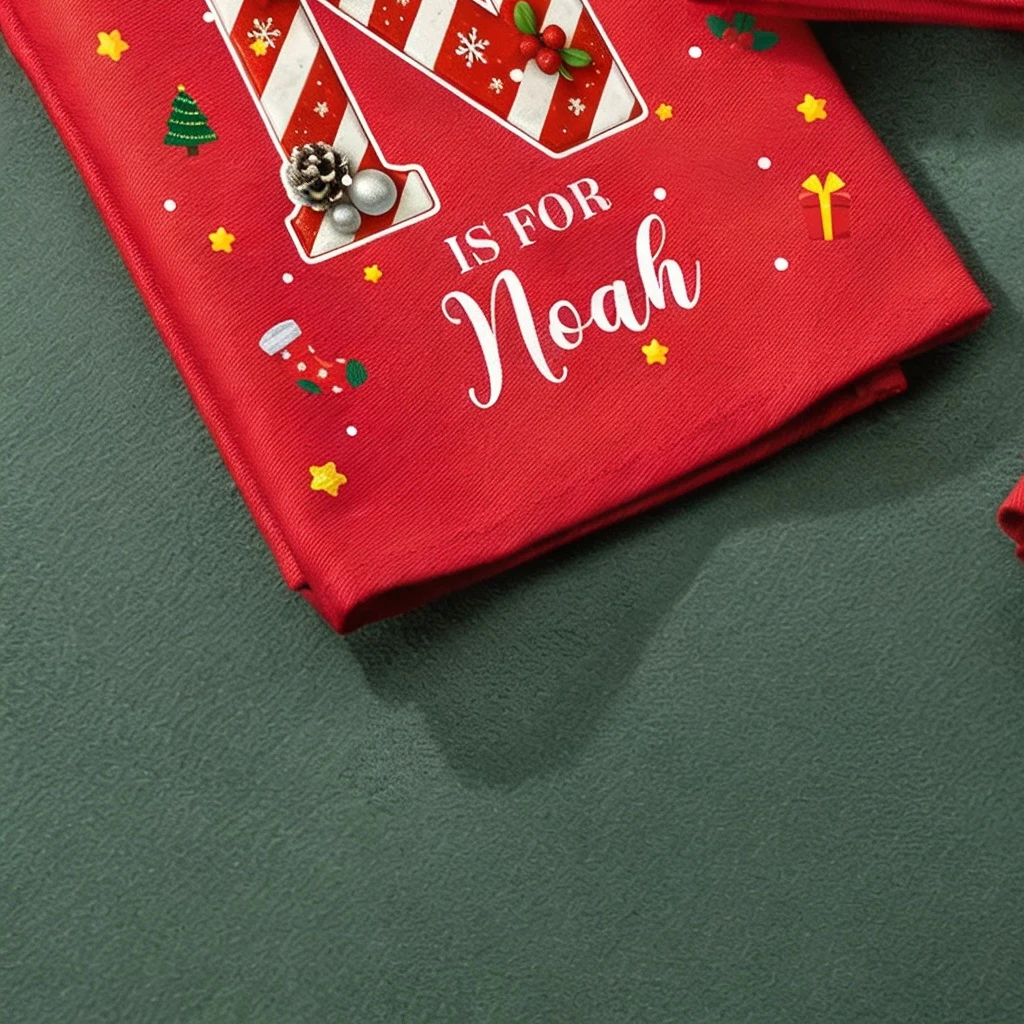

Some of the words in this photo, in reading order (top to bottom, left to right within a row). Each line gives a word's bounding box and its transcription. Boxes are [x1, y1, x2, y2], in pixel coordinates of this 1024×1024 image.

[443, 221, 501, 274] IS
[503, 177, 612, 249] FOR
[441, 213, 702, 410] Noah
